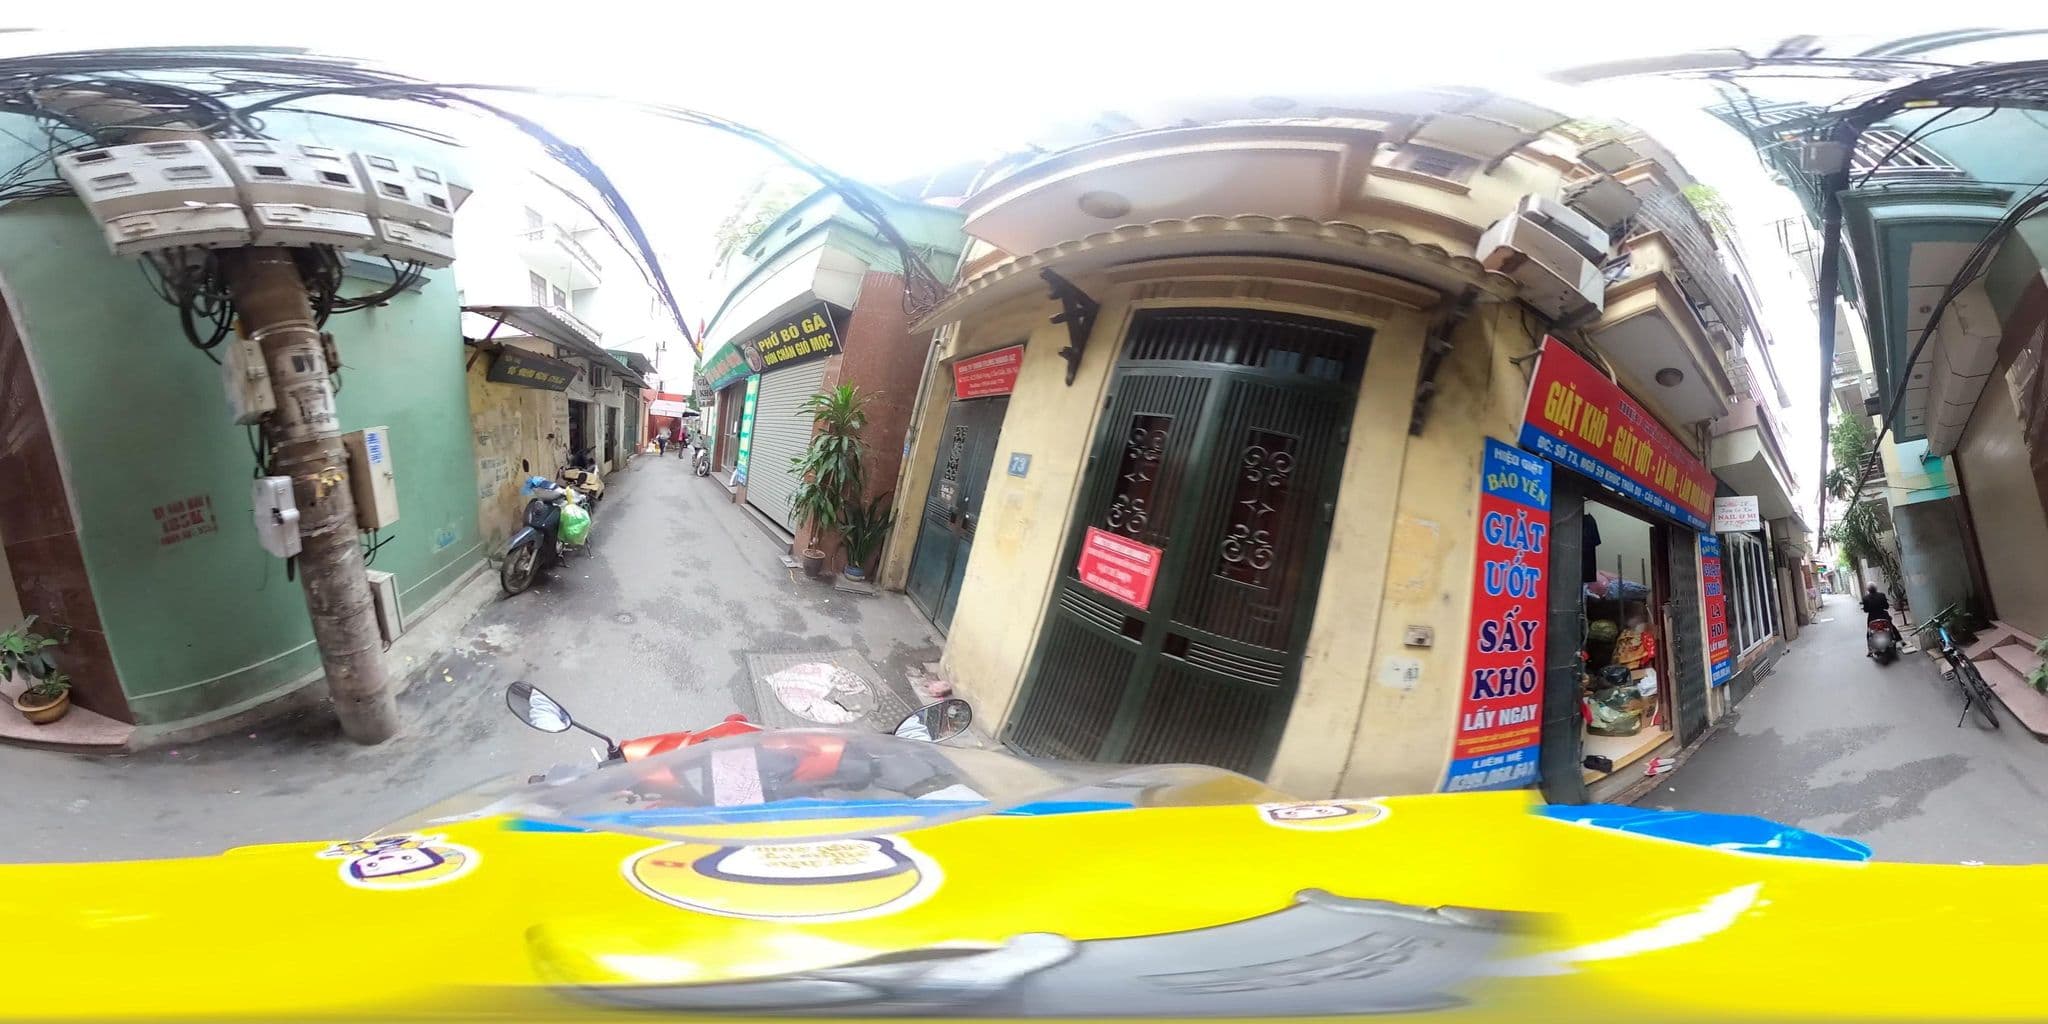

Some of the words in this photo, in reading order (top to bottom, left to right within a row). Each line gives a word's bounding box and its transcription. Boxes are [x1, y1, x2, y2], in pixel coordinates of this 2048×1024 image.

[758, 331, 780, 352] PHỞ
[779, 322, 800, 342] BÒ
[801, 312, 827, 334] GÀ
[809, 333, 834, 352] MỌC
[1544, 380, 1583, 437] GIẶT
[1578, 406, 1609, 449] KHÔ
[1612, 425, 1638, 472] GIẶT
[1013, 456, 1026, 472] 73
[1487, 465, 1519, 491] BẢO
[1520, 476, 1548, 506] YẾN
[1482, 508, 1546, 557] GIẶT
[1484, 555, 1541, 598] ƯỚT
[1477, 604, 1540, 654] SẤY
[1469, 655, 1539, 701] KHÔ
[1463, 705, 1497, 731] LẤY
[1498, 703, 1538, 727] NGAY
